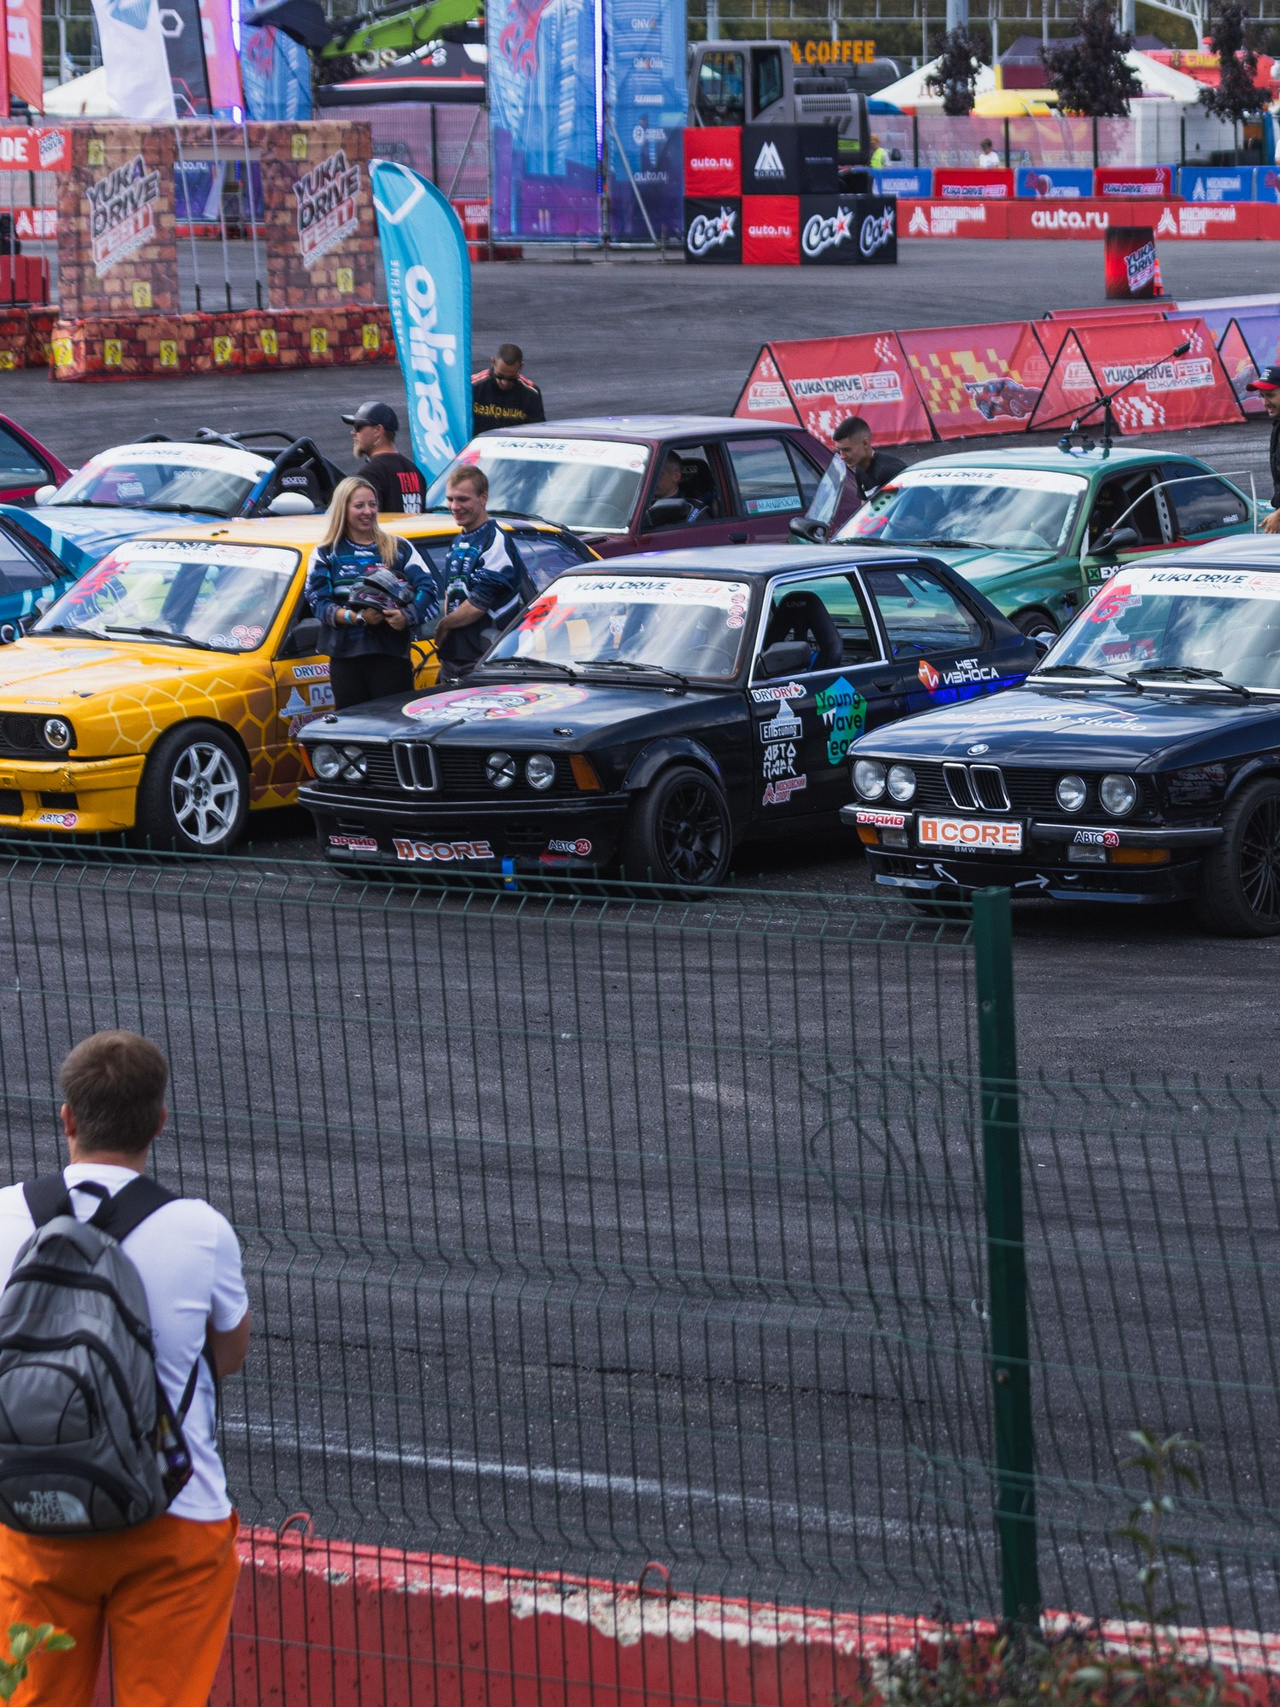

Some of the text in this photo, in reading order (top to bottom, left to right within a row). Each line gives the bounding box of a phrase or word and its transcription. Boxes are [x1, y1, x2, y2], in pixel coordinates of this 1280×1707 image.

[805, 40, 876, 64] COFFEE
[691, 157, 733, 168] auto.ru
[86, 154, 146, 203] YUKA
[293, 150, 347, 197] YUKA
[942, 185, 961, 196] YUKA
[962, 185, 984, 196] DRIVE
[1104, 184, 1121, 194] YUKA
[1121, 184, 1142, 194] DRIVE
[92, 170, 160, 239] DRIVE
[298, 165, 361, 231] DRIVE
[1031, 209, 1109, 230] auto.ru
[1179, 205, 1236, 222] МОСКОВСКИЙ
[301, 198, 355, 254] FEST
[748, 224, 791, 236] auto.ru
[1179, 221, 1206, 235] СПОРТ
[1124, 242, 1154, 266] YUKA
[1104, 365, 1134, 384] YUKA
[1135, 363, 1173, 382] DRIVE
[1177, 358, 1211, 376] FEST
[791, 372, 897, 396] YUKA DRIVE FEST
[281, 476, 308, 486] sparco
[132, 541, 167, 551] YUKA
[171, 542, 220, 552] DRIVE
[575, 581, 617, 591] YUKA
[618, 581, 671, 590] DRIVE
[1149, 573, 1190, 583] YUKA
[1192, 574, 1249, 584] DRIVE
[955, 659, 978, 669] НЕТ
[943, 667, 999, 684] ИЗНОСА
[753, 687, 793, 702] DRYDRY
[818, 690, 861, 709] Young
[1072, 716, 1147, 731] Studio
[857, 813, 905, 829] ДРАЙВ
[330, 836, 378, 848] ДРАЙВ
[954, 846, 976, 854] BMW
